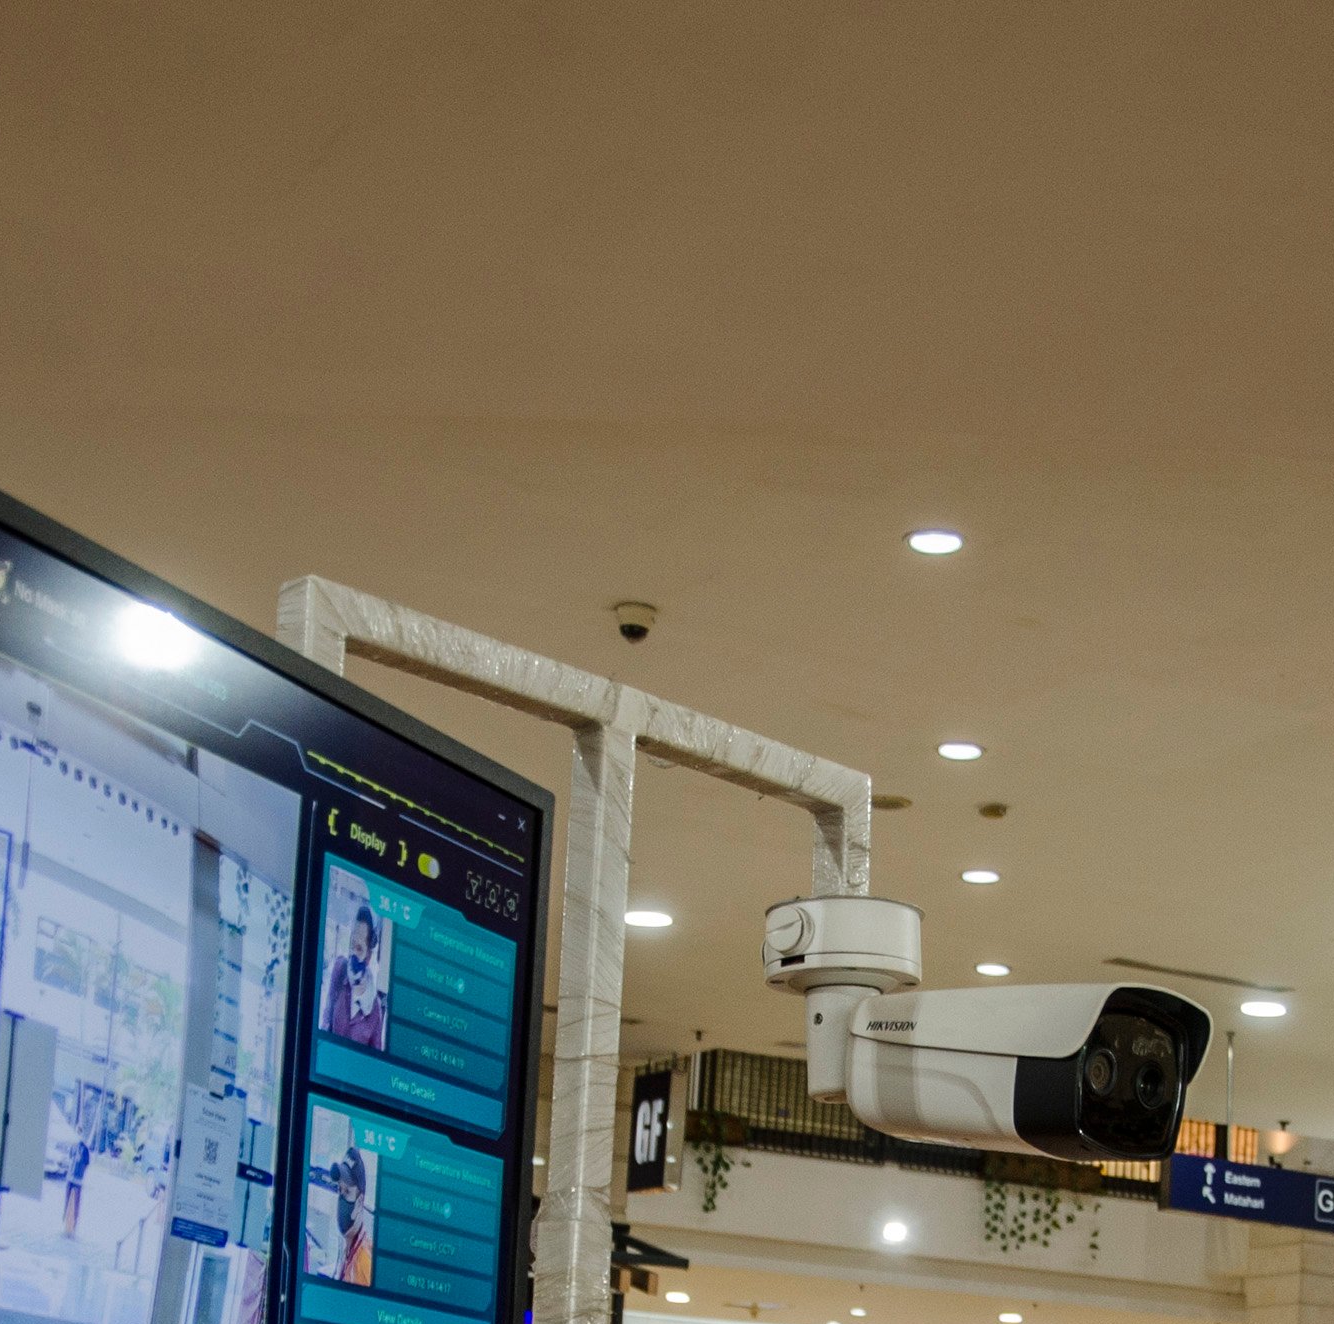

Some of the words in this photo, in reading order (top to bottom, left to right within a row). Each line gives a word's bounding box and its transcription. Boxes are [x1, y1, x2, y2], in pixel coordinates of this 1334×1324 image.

[350, 822, 387, 857] Display
[866, 1020, 917, 1032] HIKVISION
[391, 1076, 409, 1091] View
[410, 1080, 436, 1101] Details
[634, 1098, 665, 1165] GF
[1224, 1171, 1261, 1188] Eastern
[1223, 1192, 1265, 1210] Matahari
[378, 1310, 396, 1324] View
